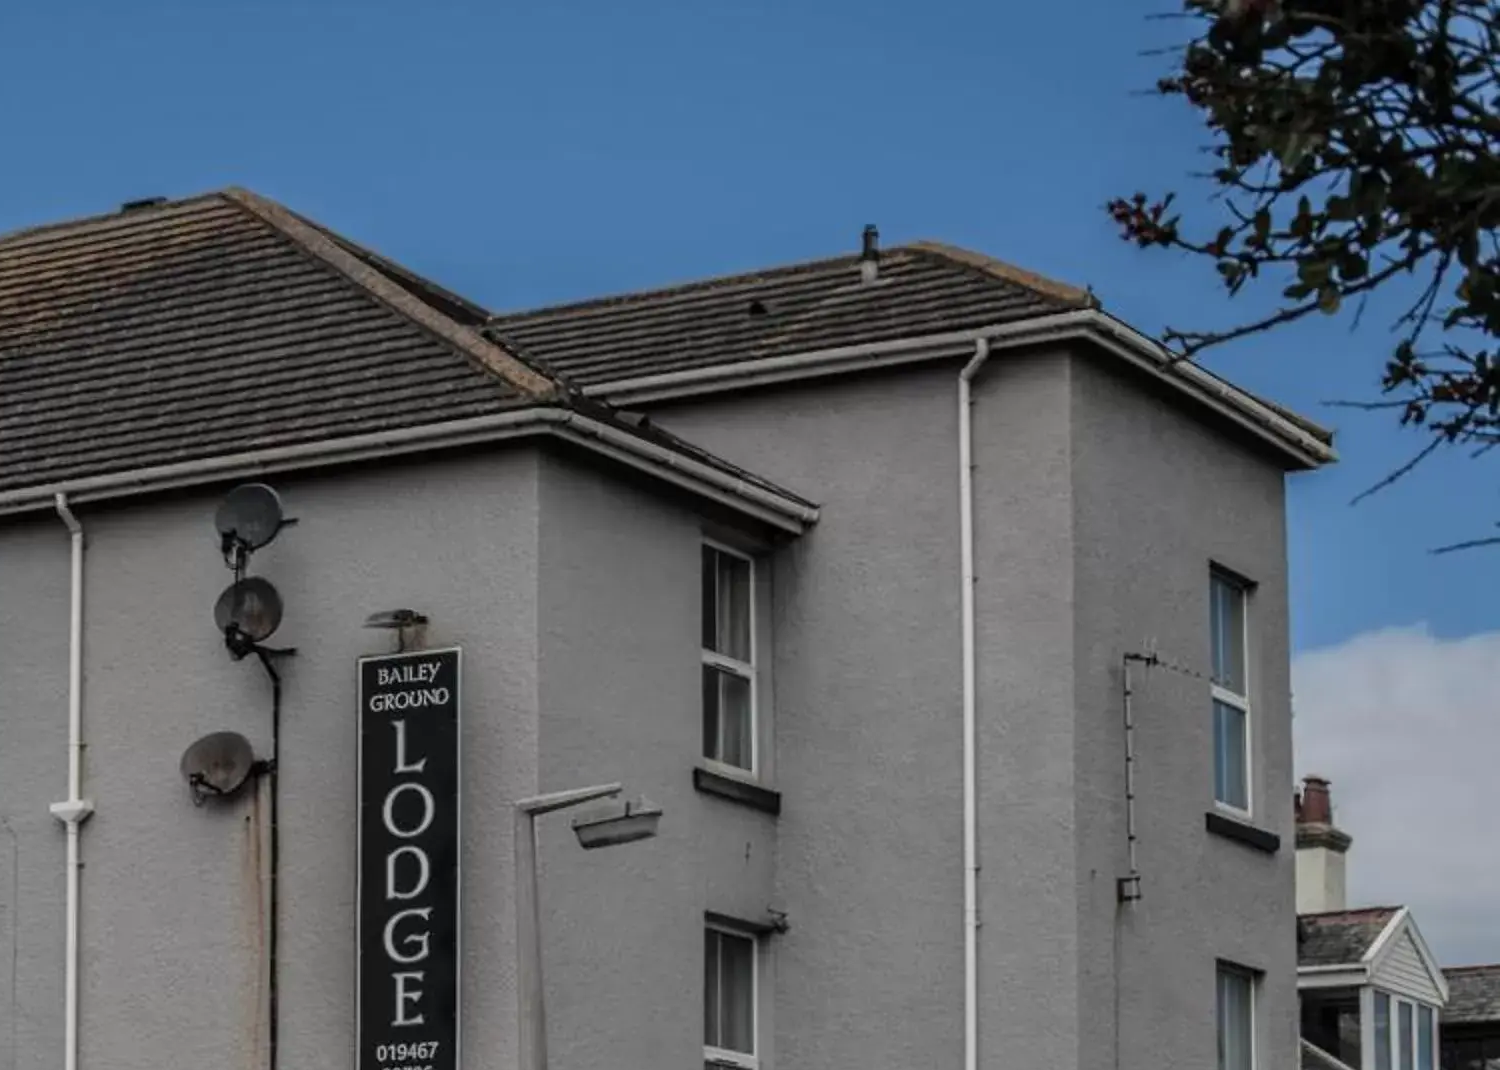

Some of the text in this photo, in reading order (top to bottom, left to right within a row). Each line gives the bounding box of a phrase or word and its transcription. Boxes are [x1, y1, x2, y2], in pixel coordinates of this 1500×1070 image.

[377, 661, 442, 685] BAILEY
[369, 687, 450, 712] GROUND
[382, 719, 436, 1027] LODGE
[376, 1041, 440, 1062] 019467
